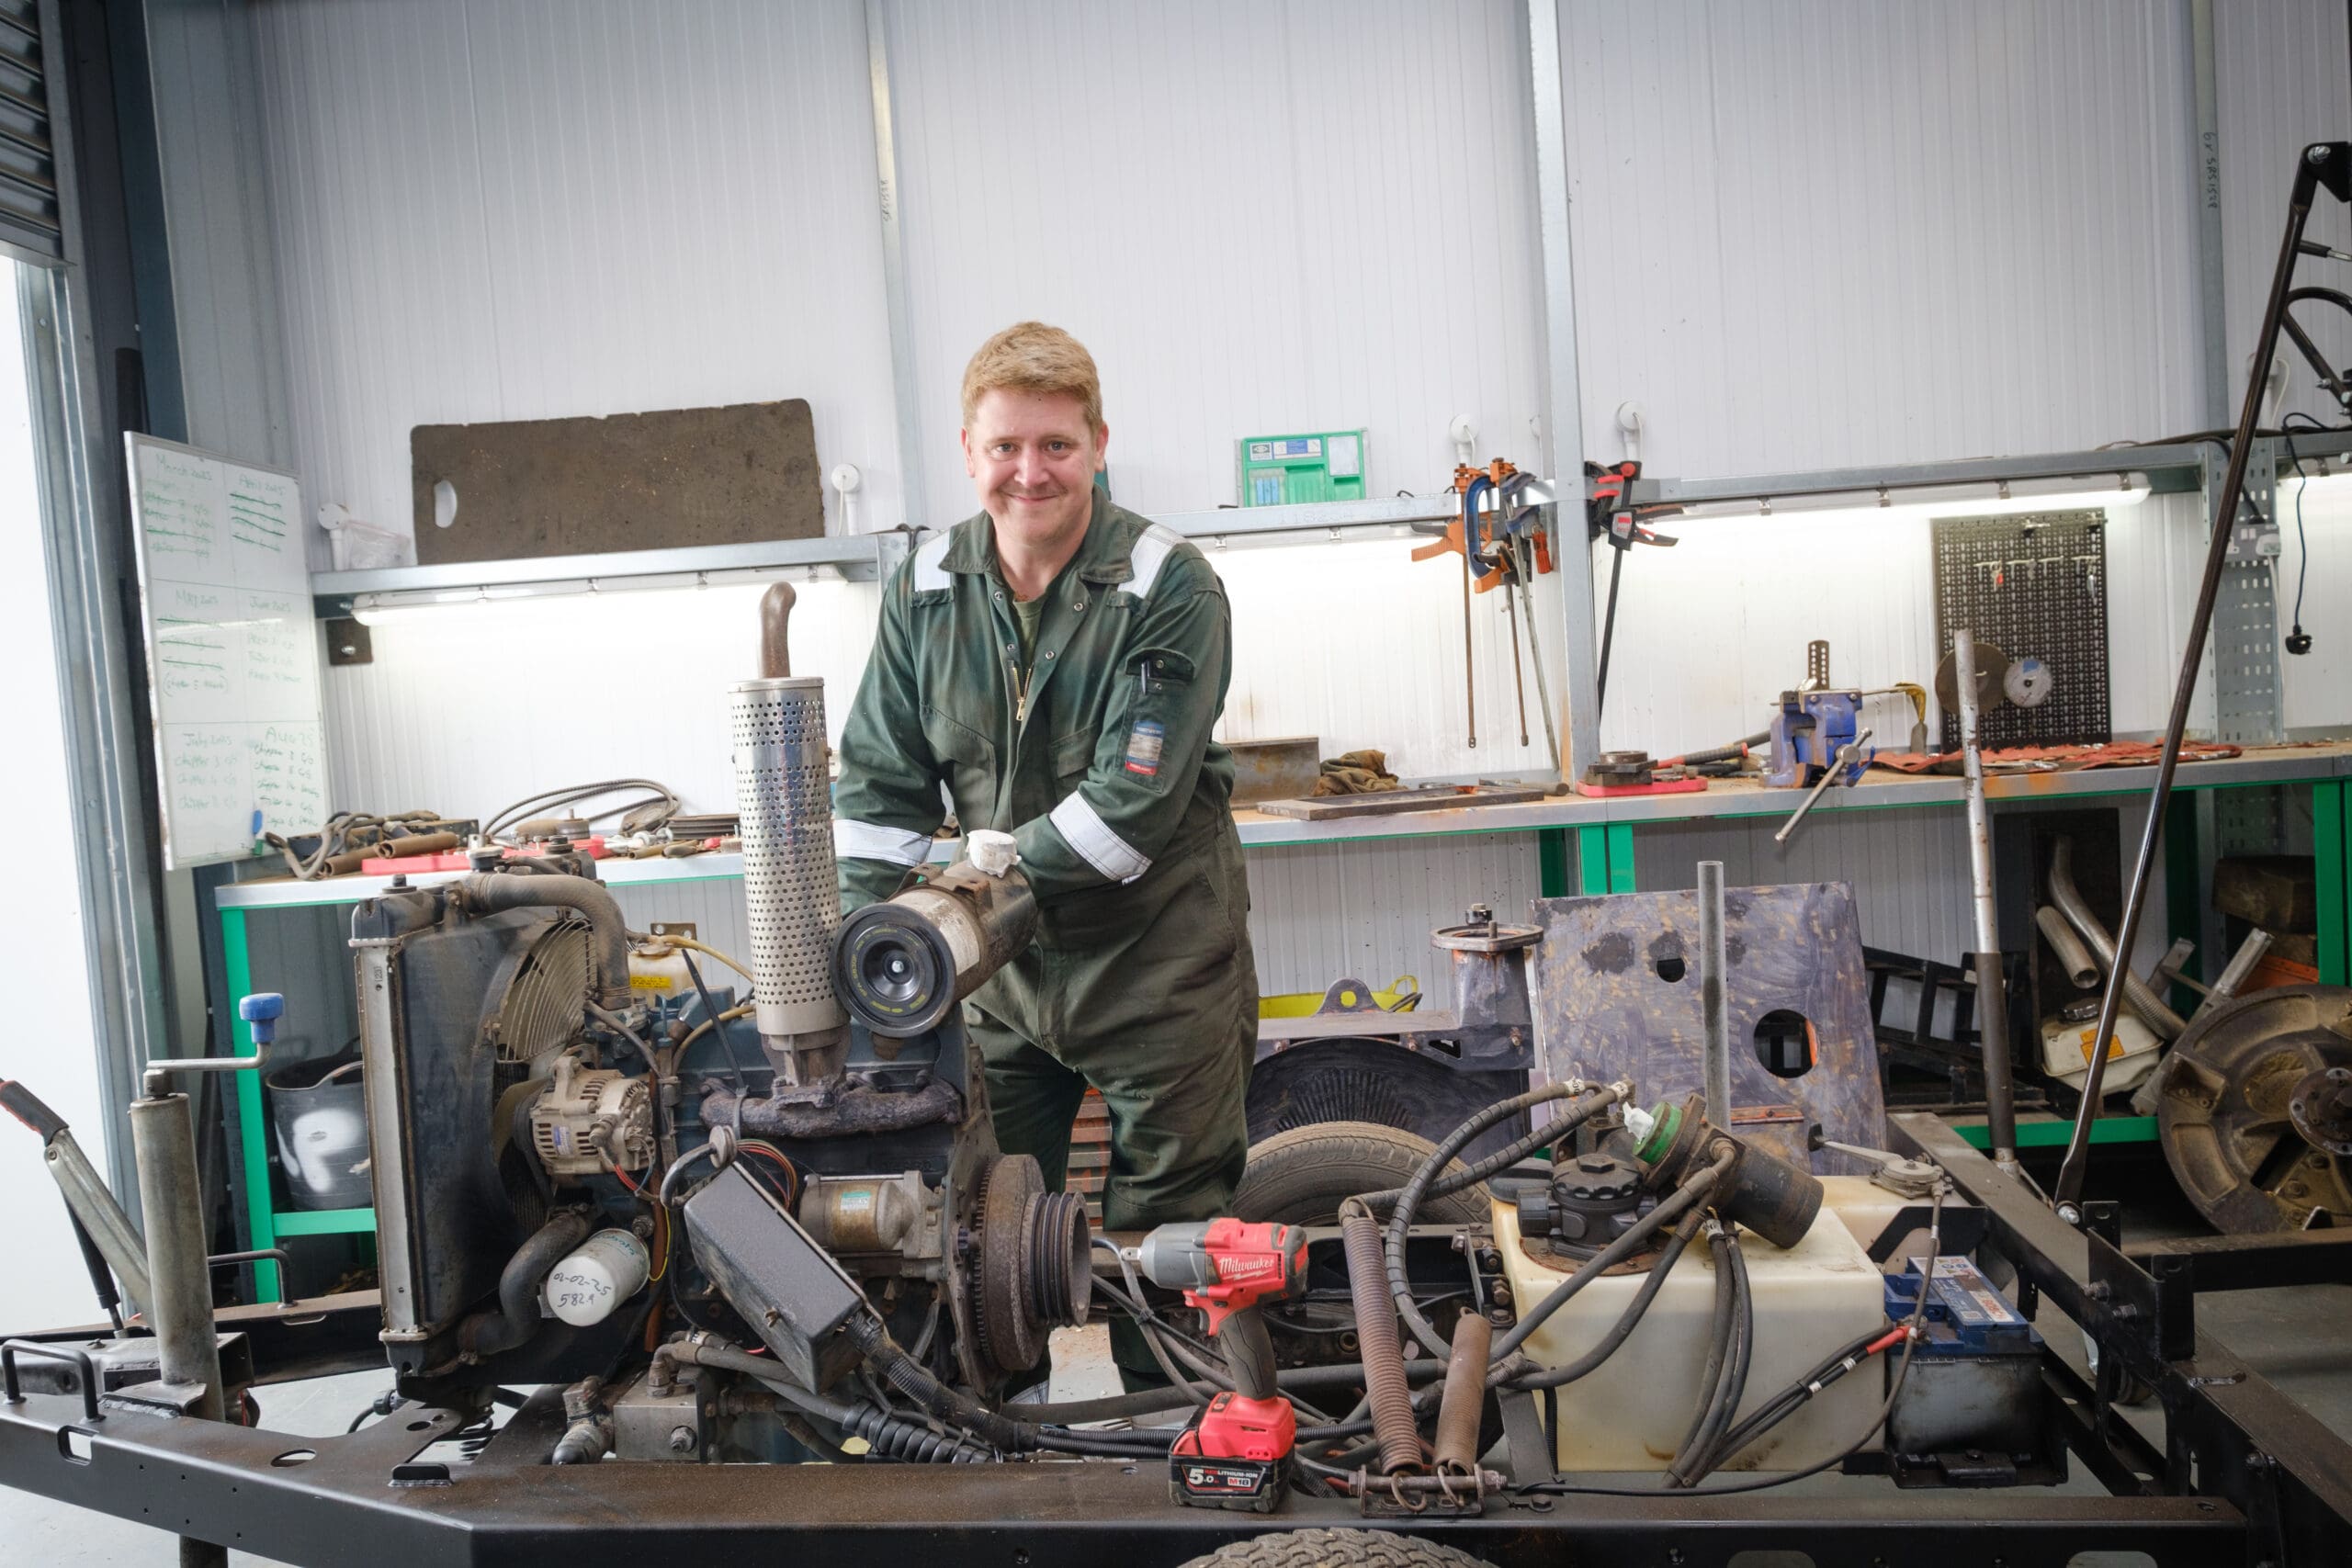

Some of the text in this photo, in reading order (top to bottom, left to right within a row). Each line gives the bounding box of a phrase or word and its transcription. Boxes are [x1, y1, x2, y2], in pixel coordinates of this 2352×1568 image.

[1219, 1257, 1274, 1274] Milwaukee
[553, 1271, 612, 1296] 02-02-25
[1228, 1477, 1250, 1487] M18
